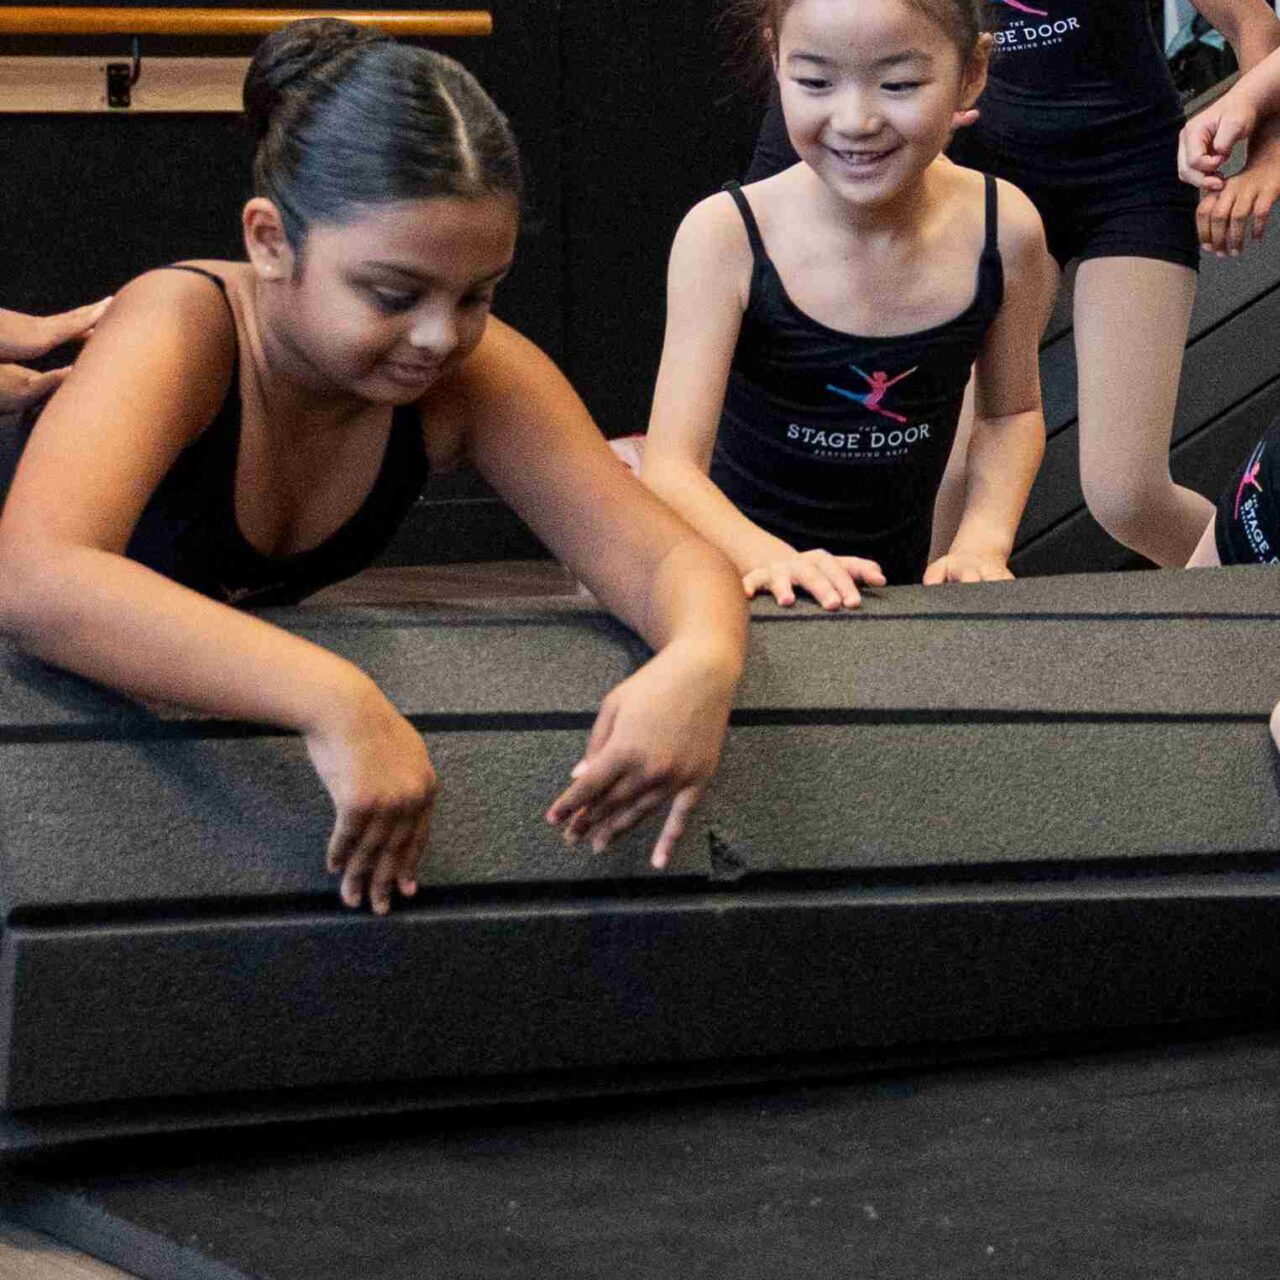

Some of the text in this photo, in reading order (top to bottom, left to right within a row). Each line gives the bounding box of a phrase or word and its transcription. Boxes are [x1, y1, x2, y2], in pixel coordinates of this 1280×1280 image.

[1023, 17, 1081, 41] DOOR
[787, 423, 931, 449] STAGE DOOR
[1244, 499, 1270, 554] STAGE
